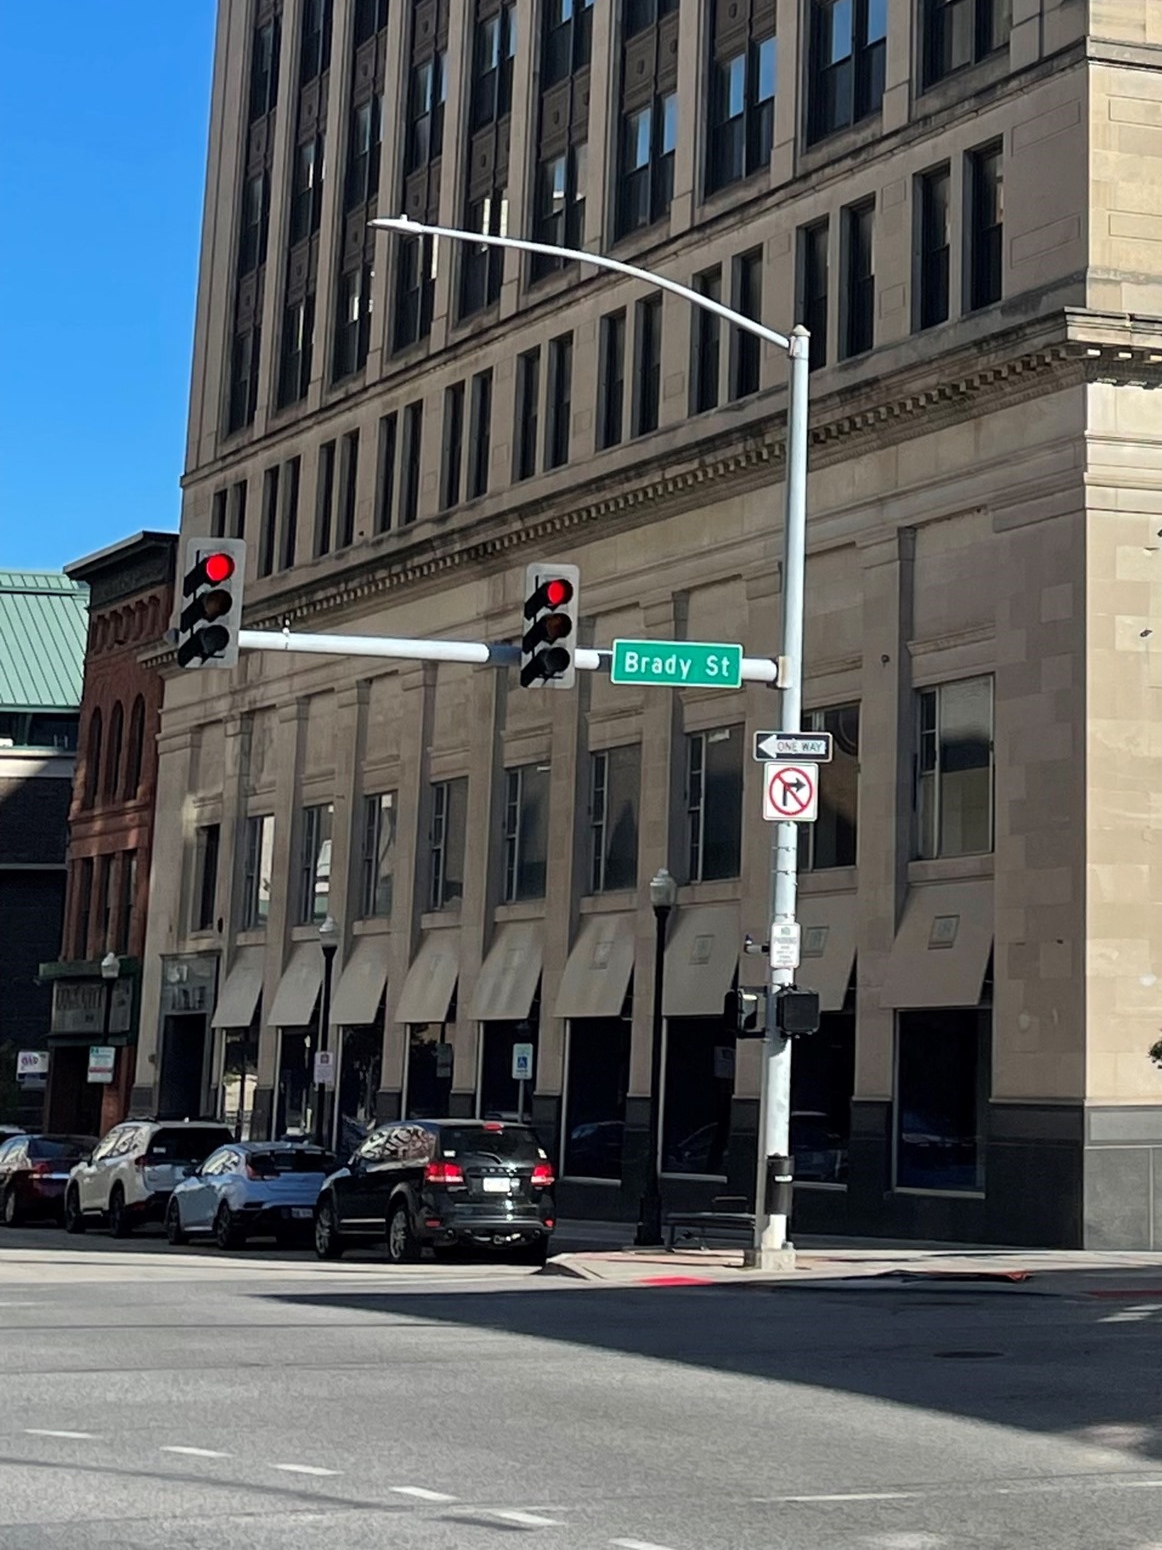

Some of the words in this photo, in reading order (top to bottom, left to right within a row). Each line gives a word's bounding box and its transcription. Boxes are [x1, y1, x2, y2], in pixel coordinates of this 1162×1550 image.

[624, 651, 692, 680] Brady
[705, 654, 730, 677] St
[777, 741, 798, 753] ONE
[801, 741, 823, 752] WAY
